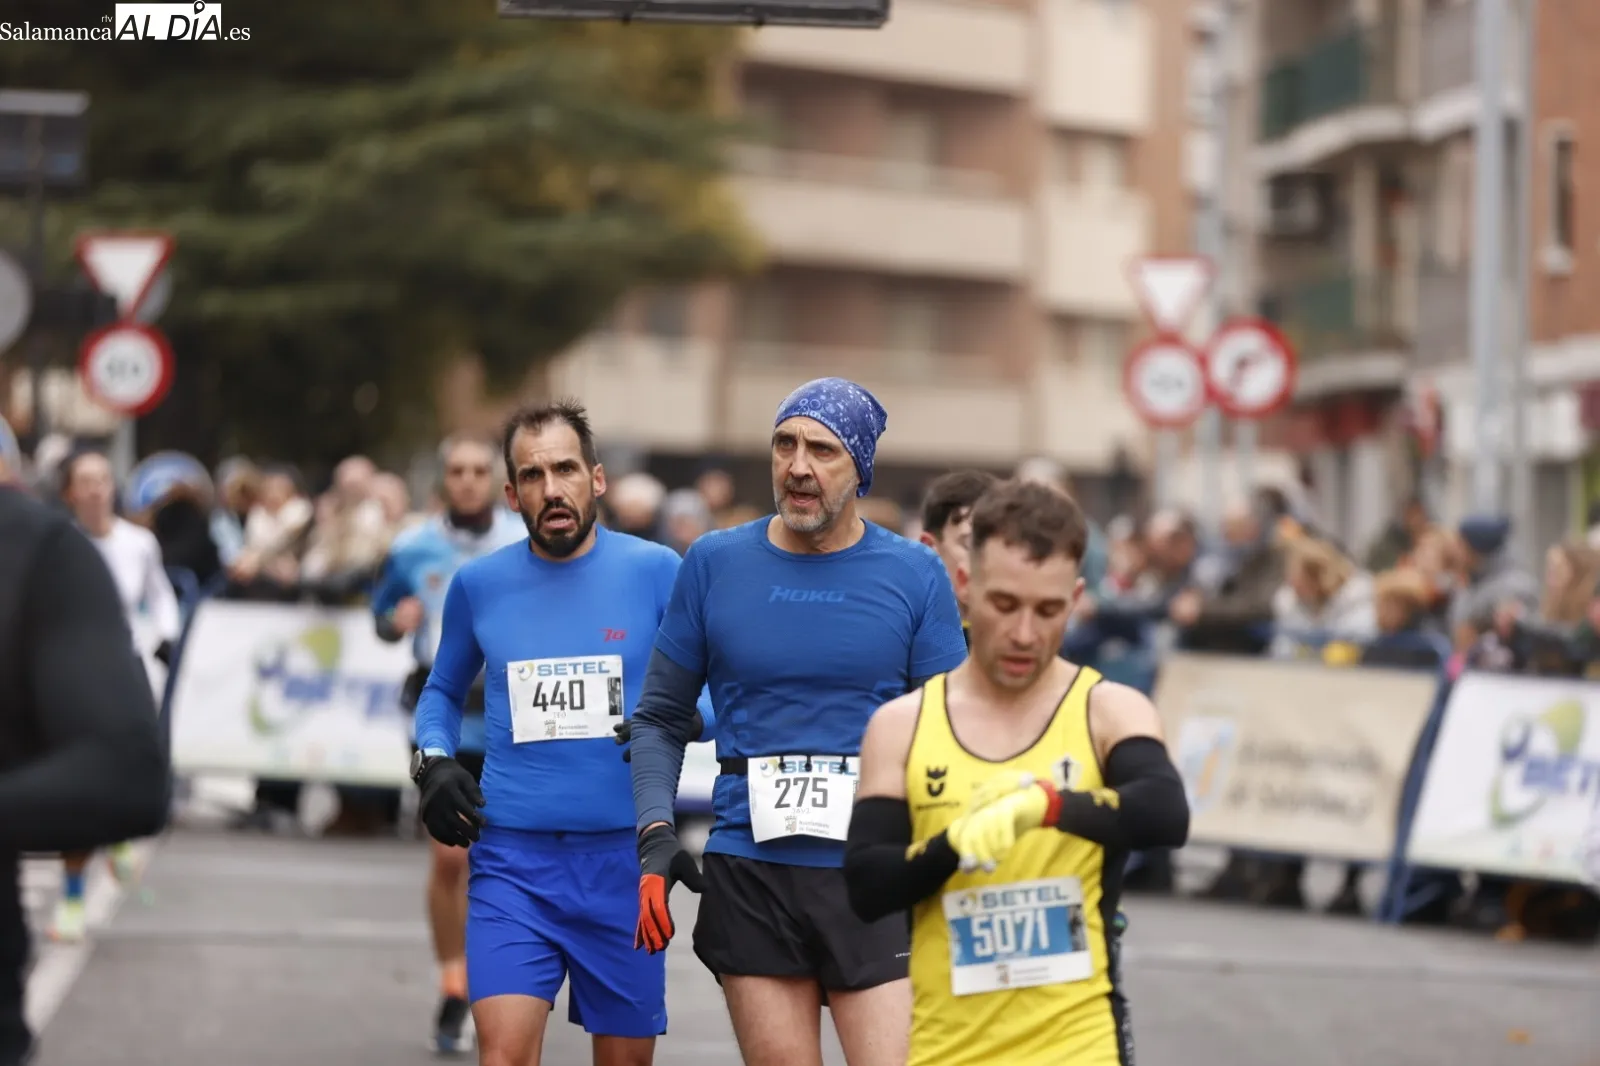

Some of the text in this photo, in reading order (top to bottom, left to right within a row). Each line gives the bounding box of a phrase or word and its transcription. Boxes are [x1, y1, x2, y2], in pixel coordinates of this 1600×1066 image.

[537, 660, 611, 677] SETEL
[532, 679, 585, 712] 440
[774, 777, 828, 809] 275
[980, 885, 1069, 909] SETEL
[970, 908, 1050, 958] 5071
